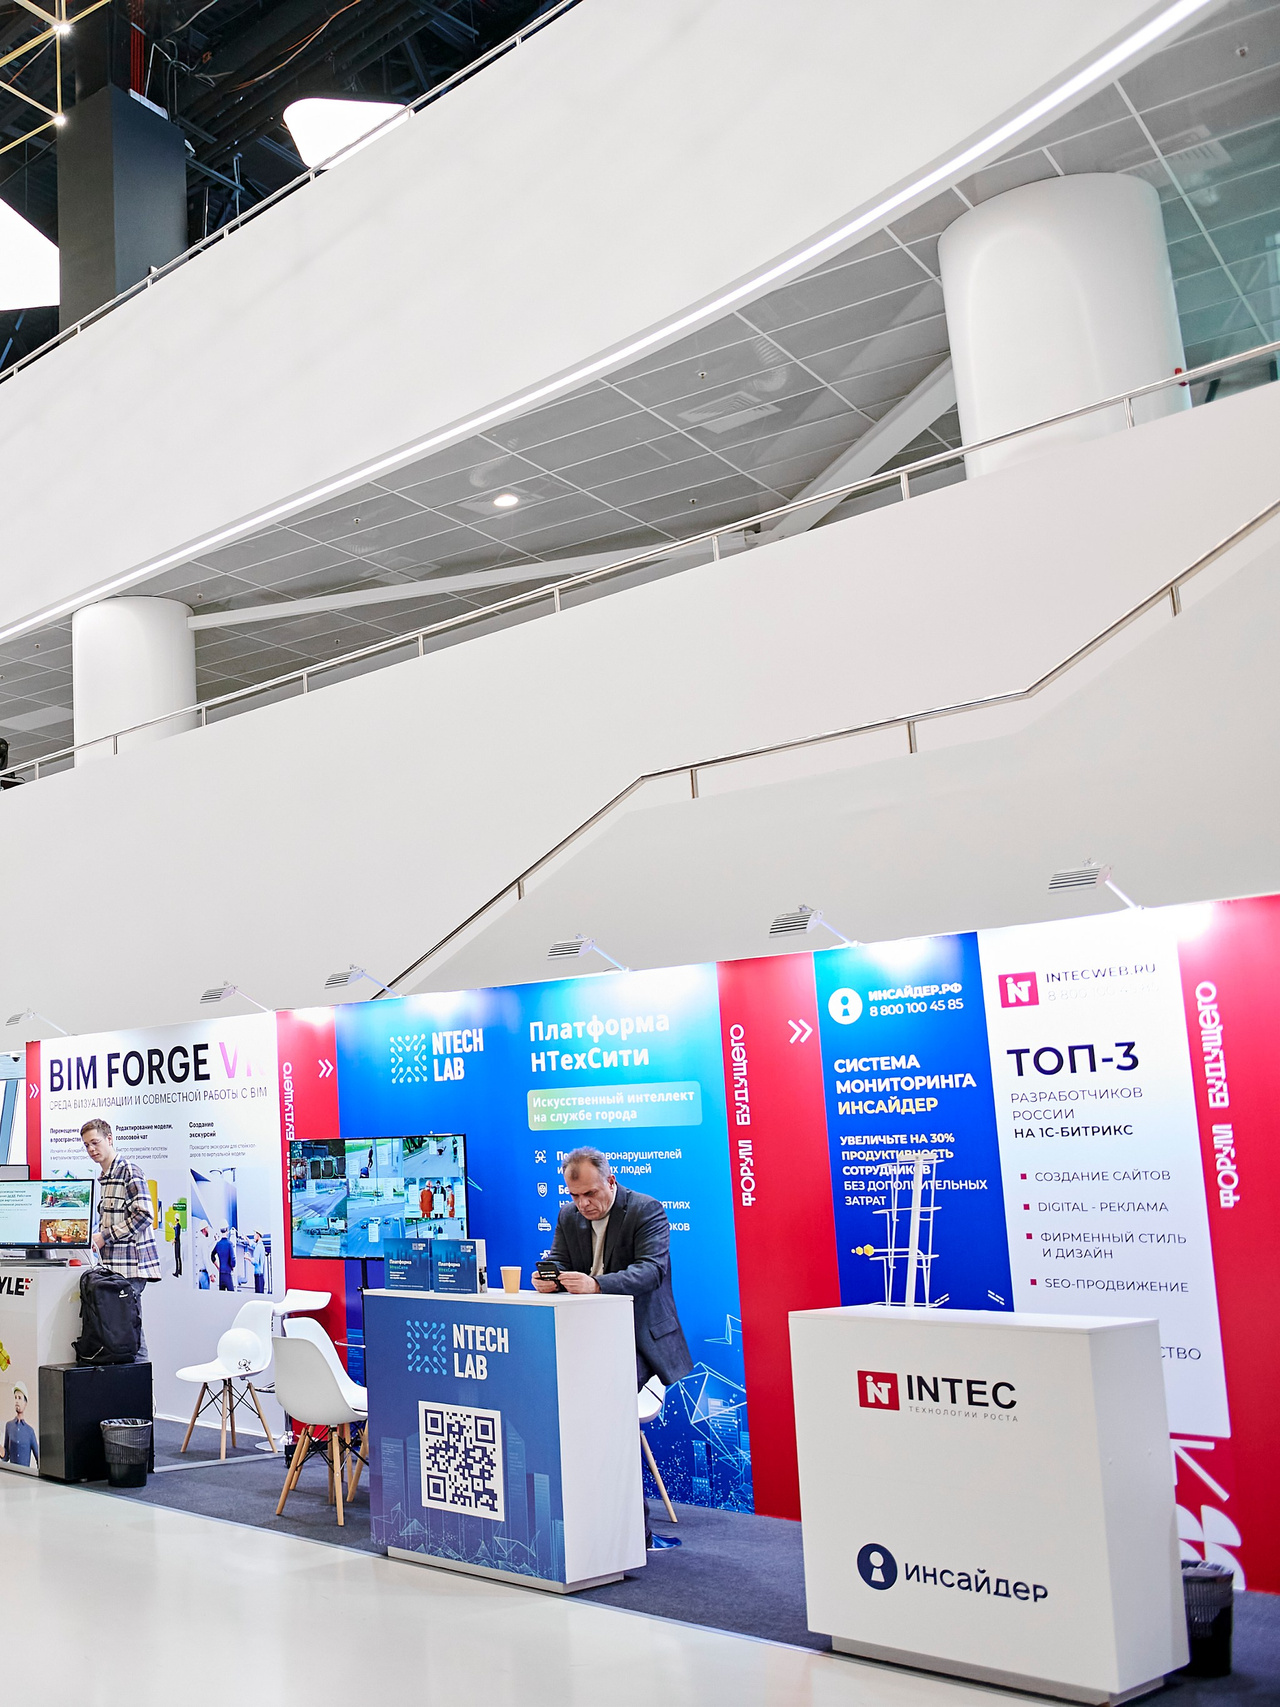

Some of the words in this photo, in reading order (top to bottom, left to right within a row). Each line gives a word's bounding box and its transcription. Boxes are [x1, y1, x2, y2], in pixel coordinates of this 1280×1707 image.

[1046, 964, 1156, 982] INTECWEB.RU
[868, 982, 962, 1002] ИНСАЙДЕР.РФ
[870, 1006, 878, 1016] 8
[880, 1004, 904, 1016] 800
[906, 1002, 927, 1014] 100
[930, 1000, 945, 1011] 45
[948, 998, 964, 1010] 85
[529, 1014, 670, 1042] Платформа
[432, 1028, 484, 1055] NTECH
[50, 1055, 98, 1092] BIM
[107, 1043, 211, 1088] FORGE
[530, 1047, 650, 1072] НТехСити
[834, 1054, 920, 1073] СИСТЕМА
[1007, 1042, 1139, 1076] ТОП-3
[434, 1058, 465, 1082] LAB
[836, 1073, 977, 1094] МОНИТОРИНГА
[74, 1096, 133, 1109] ВИЗУАЛИЗАЦИИ
[134, 1095, 140, 1105] И
[142, 1089, 200, 1104] СОВМЕСТНОЙ
[204, 1088, 238, 1100] РАБОТЫ
[241, 1087, 248, 1098] С
[250, 1086, 268, 1098] BIM
[532, 1094, 624, 1109] Искусственный
[628, 1091, 694, 1104] интеллект
[1011, 1087, 1142, 1103] РАЗРАБОТЧИКОВ
[838, 1096, 938, 1115] ИНСАЙДЕР
[1012, 1109, 1075, 1120] РОССИИ
[534, 1114, 546, 1122] на
[550, 1110, 592, 1124] службе
[596, 1110, 638, 1122] города
[190, 1130, 216, 1139] экскурсий
[840, 1135, 908, 1146] УВЕЛИЧЬТЕ
[910, 1134, 928, 1144] НА
[930, 1133, 955, 1143] 30%
[1014, 1128, 1035, 1138] НА
[1039, 1124, 1134, 1138] 1С-БИТРИКС
[620, 1163, 652, 1176] людей
[738, 1140, 756, 1206] ФОРУМ
[842, 1164, 931, 1176] СОТРУДНИКВ
[1212, 1123, 1240, 1208] ФОРУМ
[1035, 1171, 1110, 1182] СОЗДАНИЕ
[1112, 1168, 1171, 1182] САЙТОВ
[844, 1181, 865, 1190] БЕЗ
[845, 1196, 886, 1206] ЗАТРАТ
[1038, 1202, 1088, 1212] DIGITAL
[1100, 1202, 1168, 1212] РЕКЛАМА
[1040, 1231, 1134, 1243] ФИРМЕННЫЙ
[1138, 1233, 1187, 1244] СТИЛЬ
[1042, 1248, 1052, 1258] И
[1056, 1246, 1114, 1260] ДИЗАЙН
[1044, 1278, 1190, 1292] SEO-ПРОДВИЖЕНИЕ
[453, 1324, 509, 1354] NTECH
[454, 1352, 488, 1380] LAB
[907, 1374, 1017, 1410] INTEC
[909, 1406, 978, 1419] ТЕХНОЛОГИИ
[984, 1412, 1018, 1422] РОСТА
[904, 1562, 1048, 1602] инсайдер
